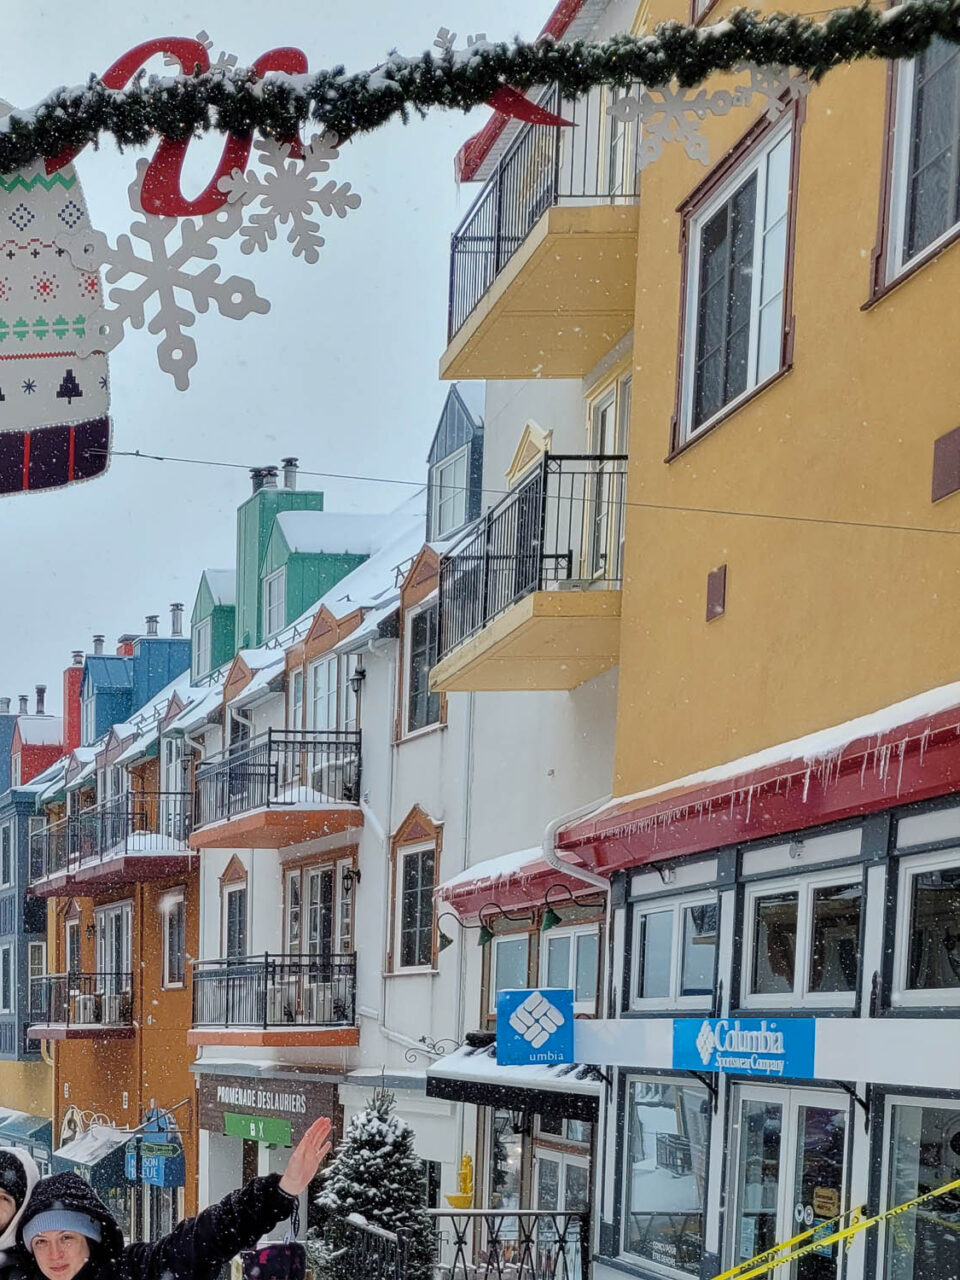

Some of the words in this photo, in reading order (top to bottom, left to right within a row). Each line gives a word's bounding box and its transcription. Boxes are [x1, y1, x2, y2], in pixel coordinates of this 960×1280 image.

[714, 1019, 785, 1053] Columbia
[751, 1054, 785, 1076] Company
[217, 1086, 256, 1107] PROMENADE
[257, 1091, 307, 1113] DESLAURIERS
